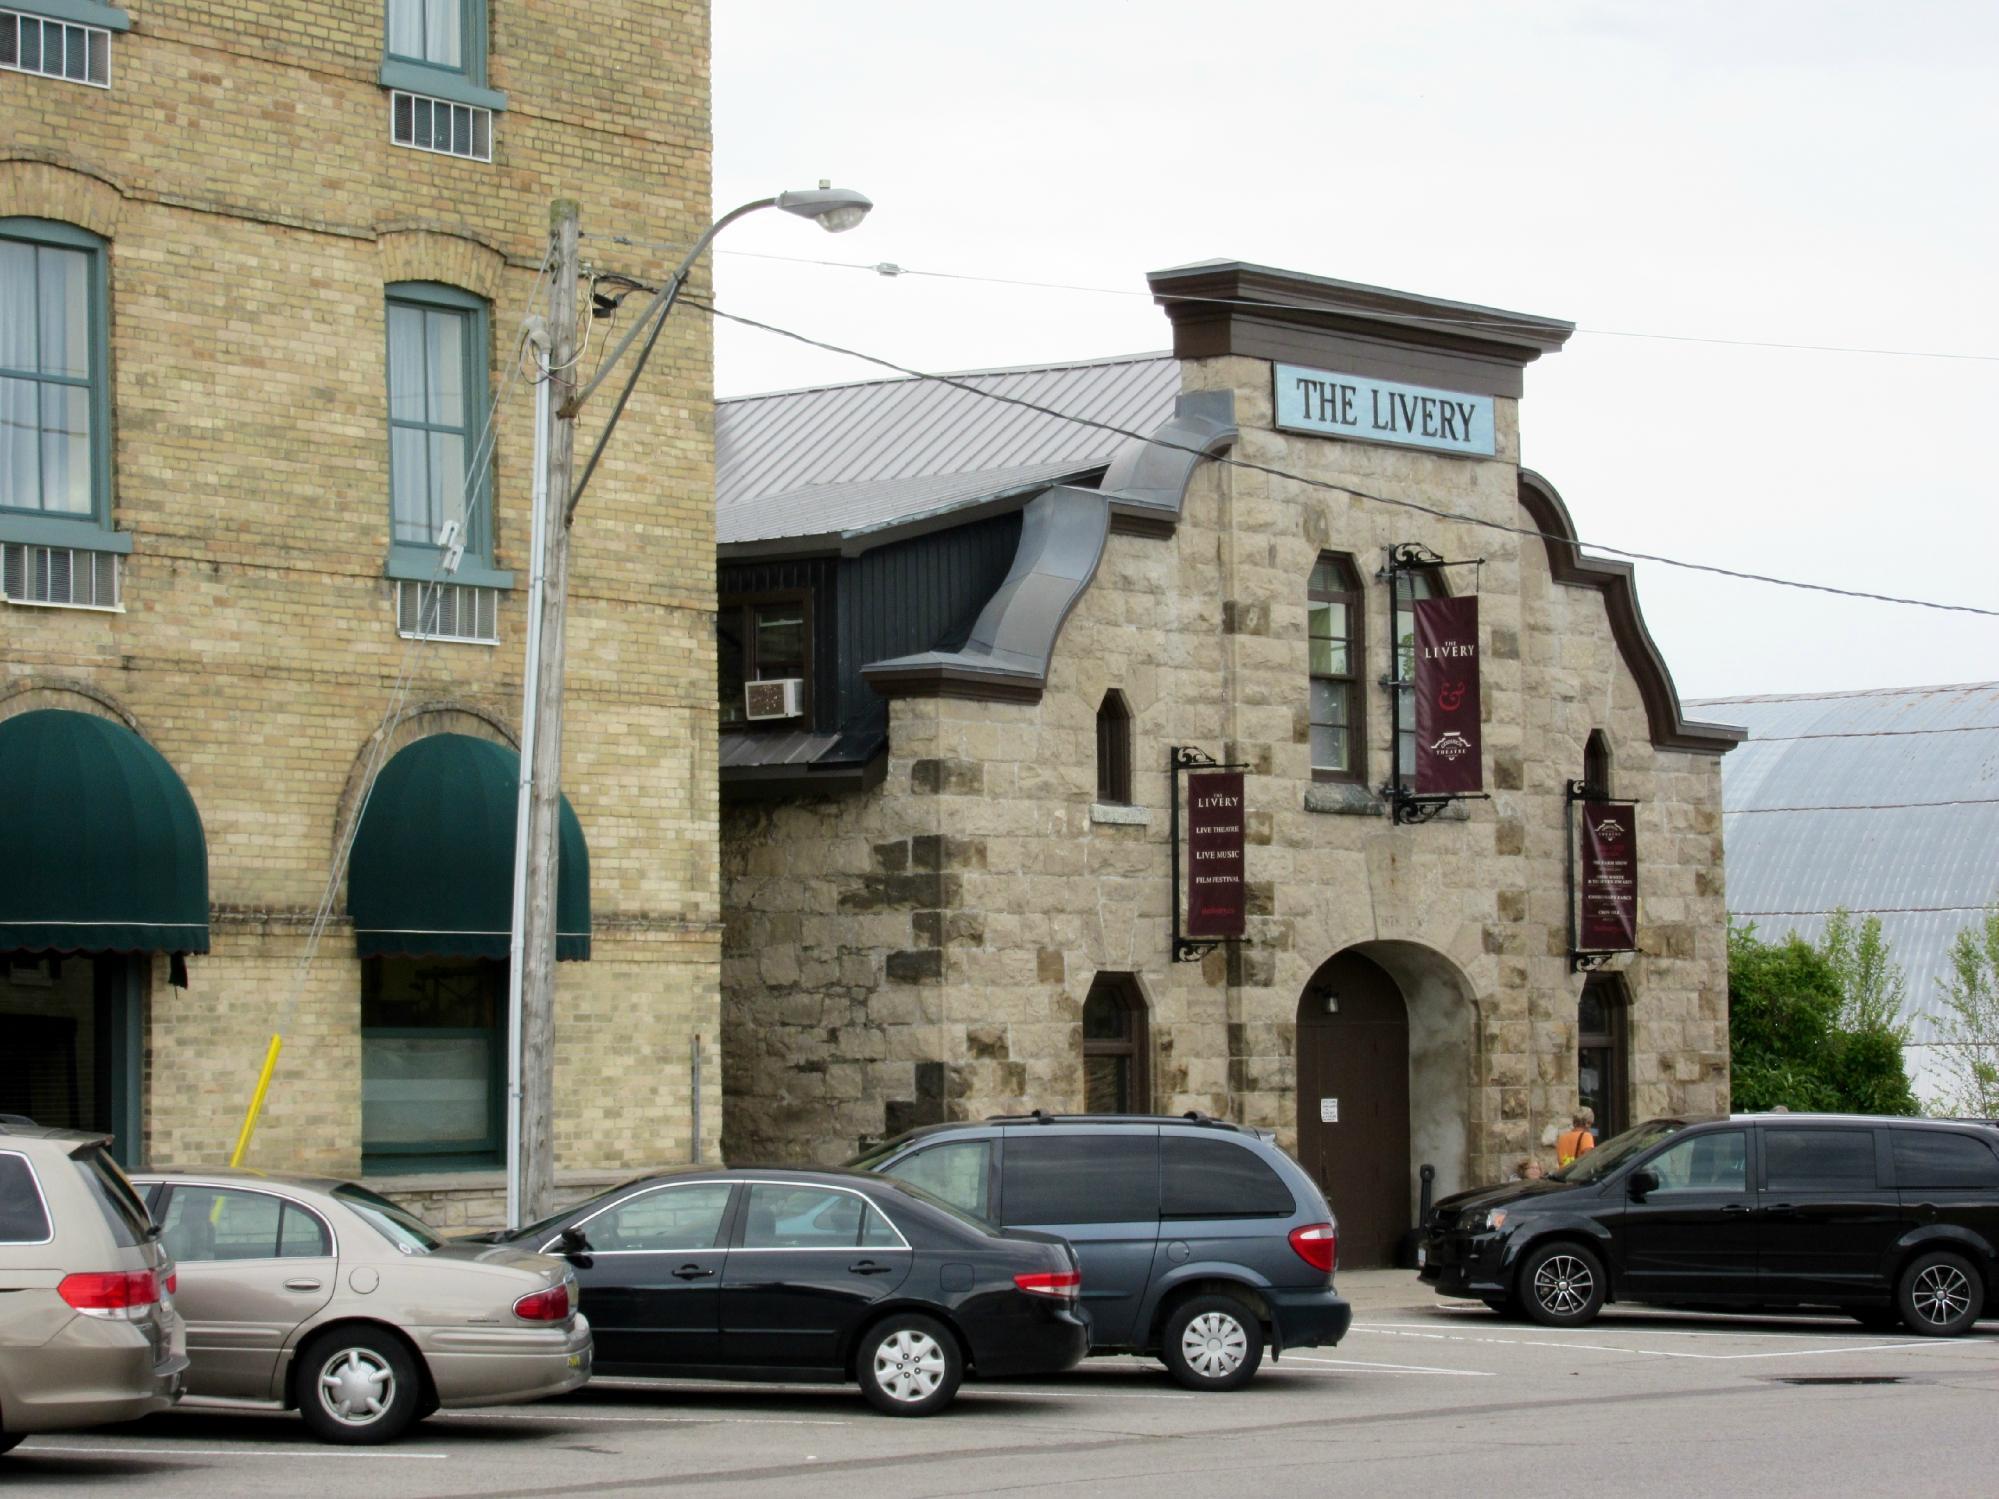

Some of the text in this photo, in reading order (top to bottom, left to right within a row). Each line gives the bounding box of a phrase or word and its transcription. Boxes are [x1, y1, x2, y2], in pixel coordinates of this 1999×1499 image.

[1296, 377, 1476, 442] THE LIVERY
[1425, 644, 1475, 659] LIVERY
[1439, 680, 1465, 711] &
[1198, 796, 1239, 808] LIVERY
[1196, 825, 1240, 834] LIVE THEATRE
[1196, 850, 1241, 860] LIVE MUSIC
[1195, 876, 1212, 884] FILM
